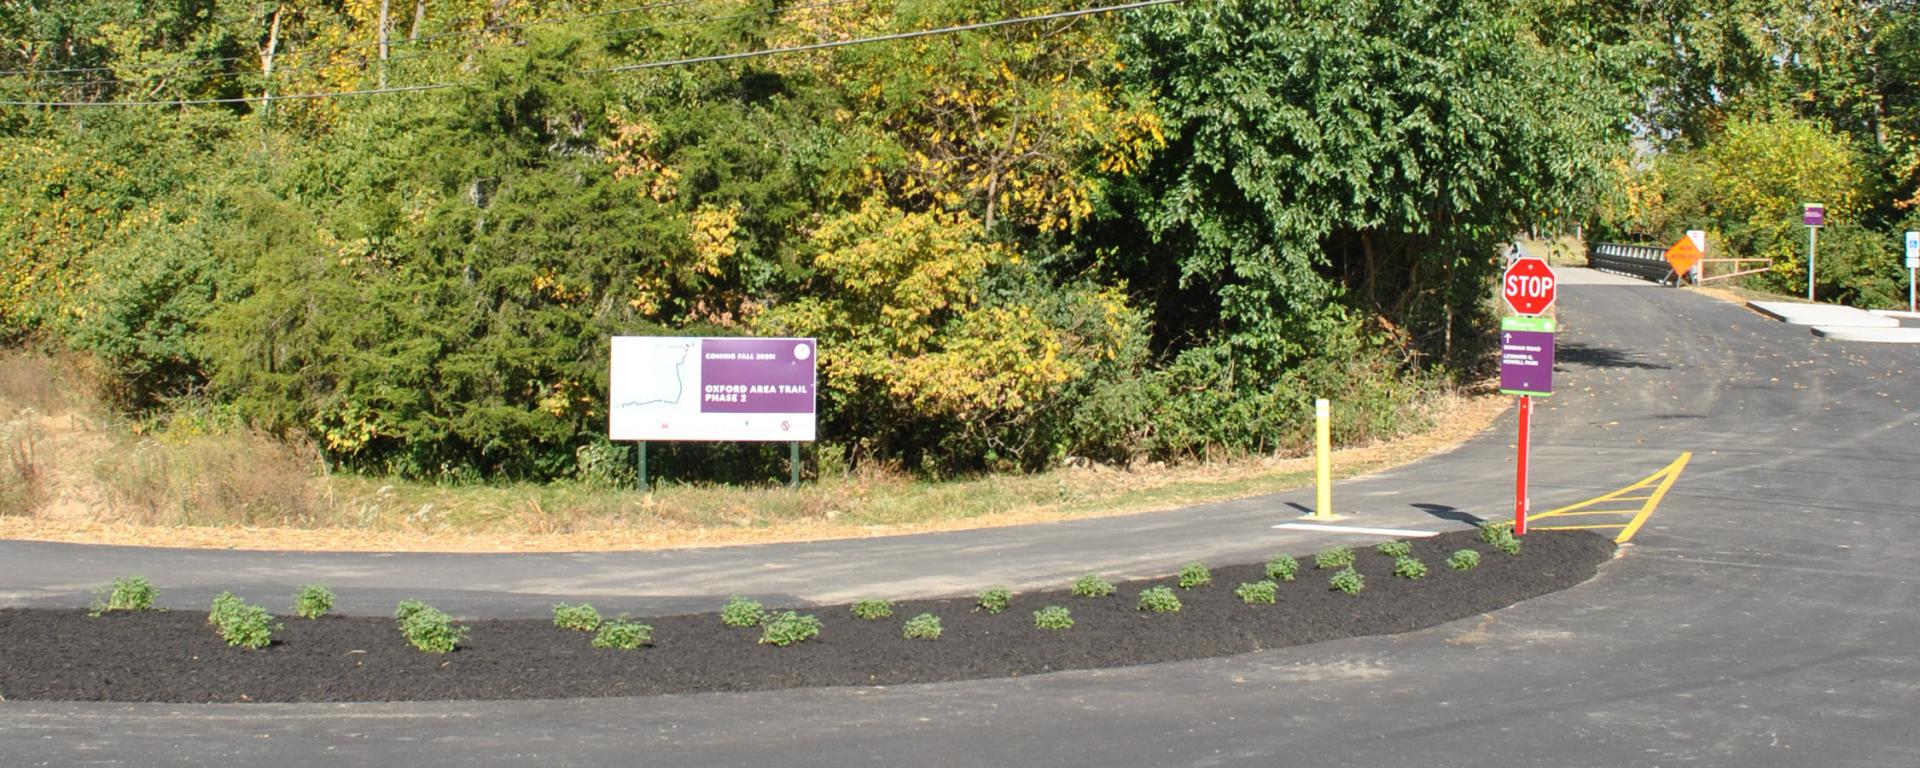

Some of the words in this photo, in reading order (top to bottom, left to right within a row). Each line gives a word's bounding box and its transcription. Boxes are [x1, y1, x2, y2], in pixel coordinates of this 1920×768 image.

[1506, 274, 1553, 298] STOP
[705, 385, 747, 393] OXFORD
[749, 385, 776, 393] AREA
[778, 385, 807, 394] TRAIL
[705, 394, 738, 402] PHASE
[740, 394, 747, 402] 2
